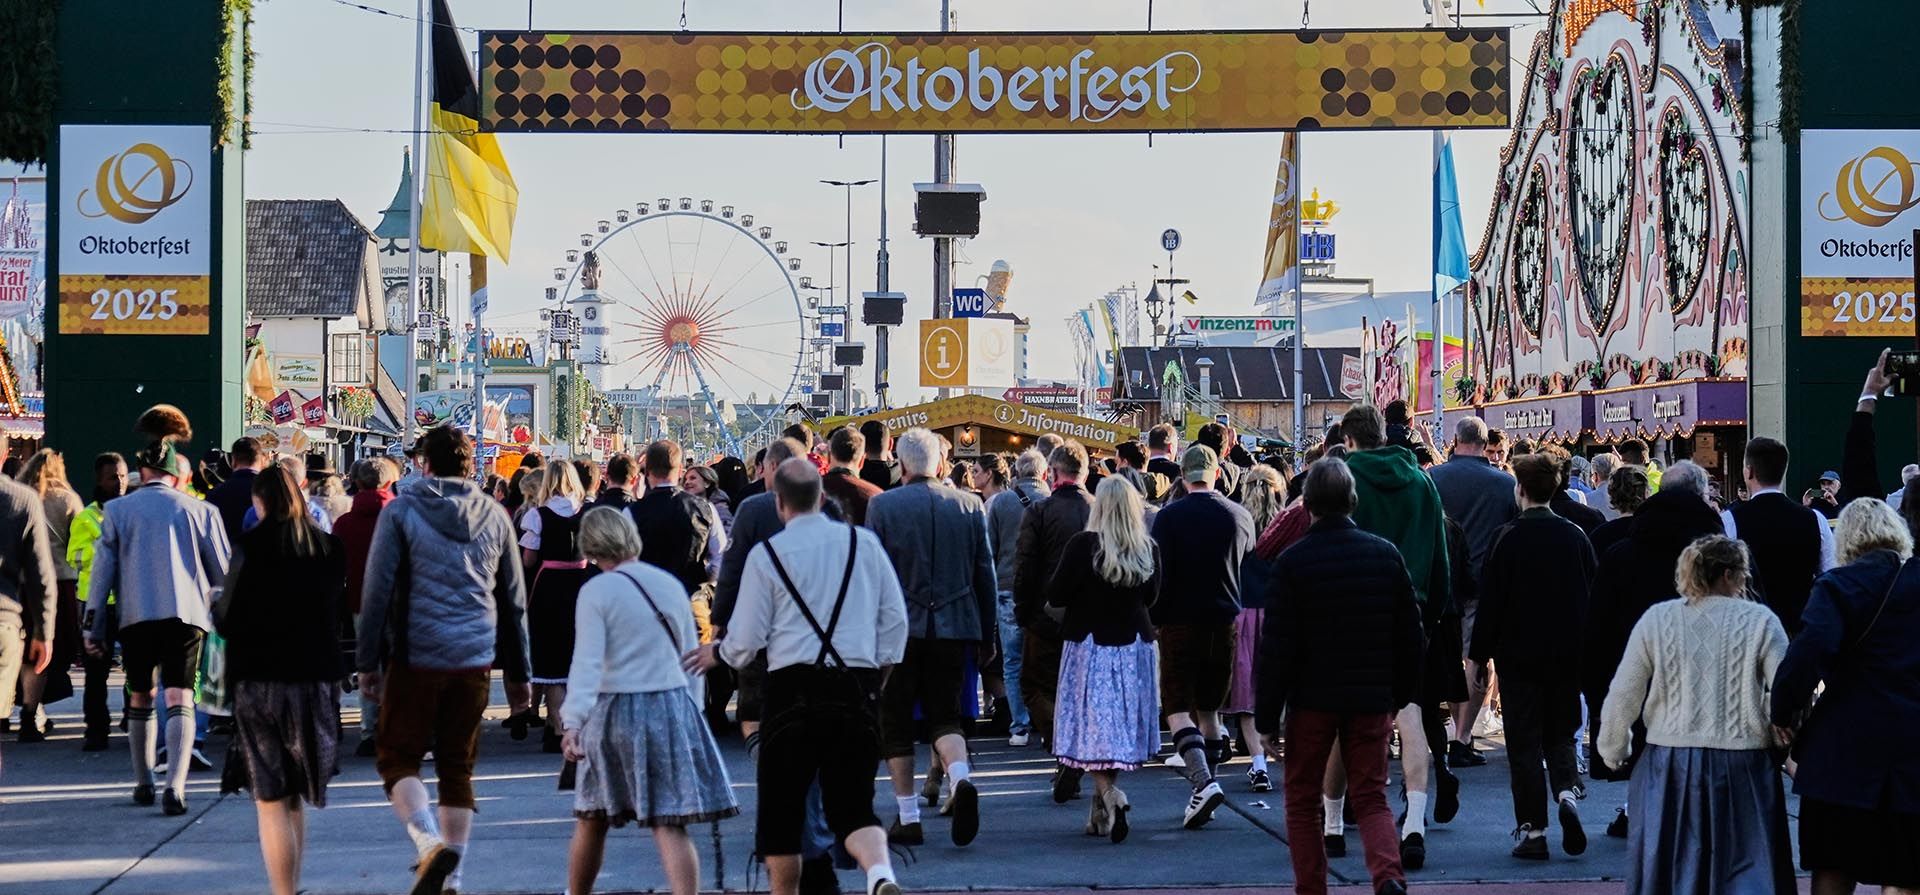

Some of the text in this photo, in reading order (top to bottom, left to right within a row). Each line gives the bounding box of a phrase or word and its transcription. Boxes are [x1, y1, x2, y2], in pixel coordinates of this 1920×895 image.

[791, 42, 1201, 122] Oktoberfest
[79, 235, 191, 259] Oktoberfest
[1165, 239, 1177, 249] HB
[1301, 233, 1335, 259] HB
[1820, 238, 1913, 262] Oktoberfe
[9, 257, 32, 268] Meter
[0, 269, 30, 286] rat-
[0, 285, 28, 302] urst
[90, 288, 178, 320] 2025
[956, 295, 982, 312] WC
[1832, 291, 1916, 323] 2025
[1187, 315, 1296, 331] vinzenzmurr
[1024, 395, 1078, 404] HAXNBRATERE
[846, 410, 929, 433] Senirs
[1017, 408, 1116, 443] Information
